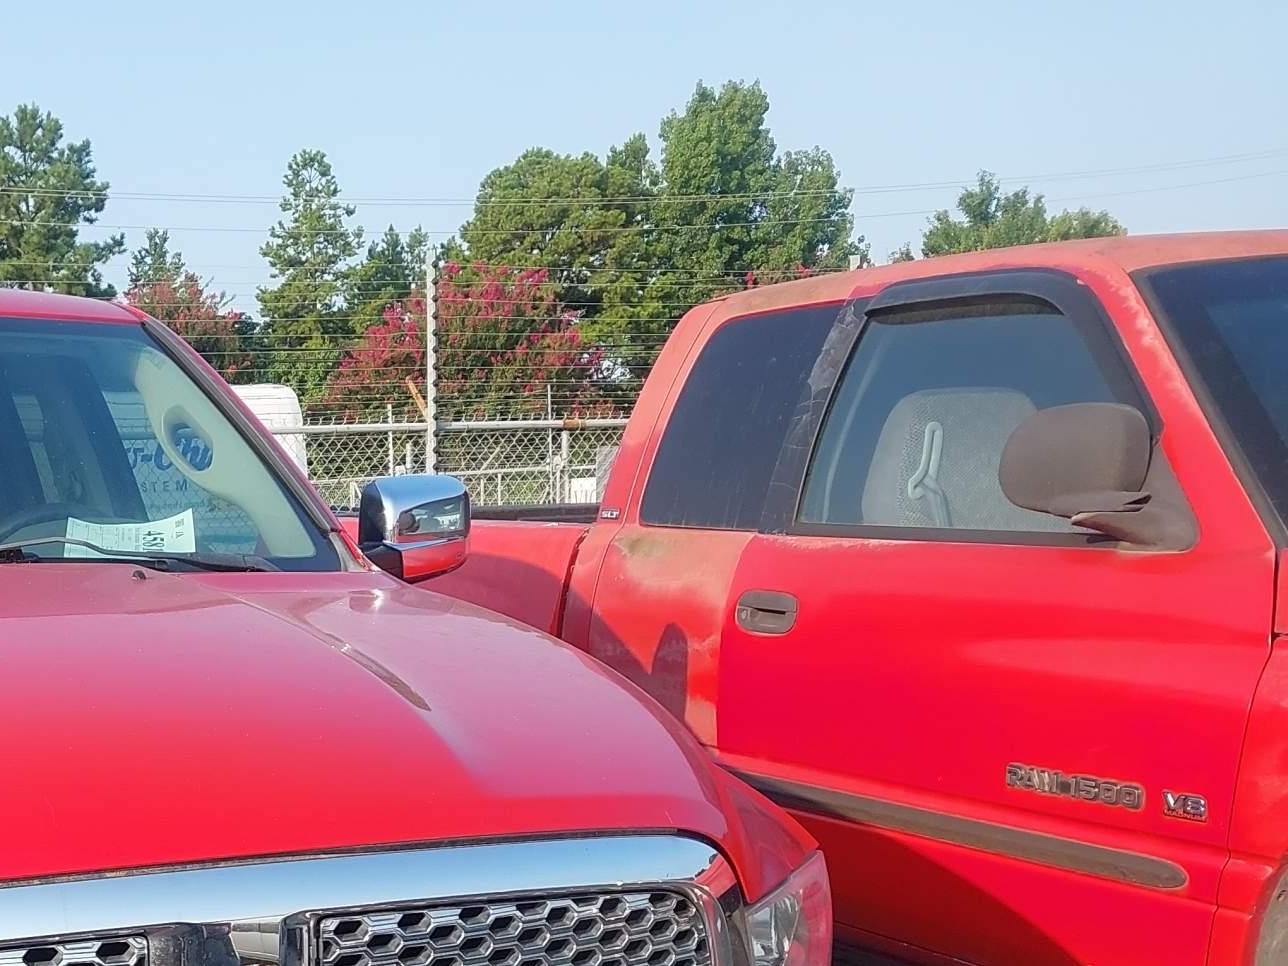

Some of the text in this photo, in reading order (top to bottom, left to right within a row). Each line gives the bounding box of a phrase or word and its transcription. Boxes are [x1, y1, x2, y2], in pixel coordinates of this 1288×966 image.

[601, 510, 620, 519] SLT
[1006, 763, 1144, 810] RAM 1500
[1162, 791, 1207, 817] V8
